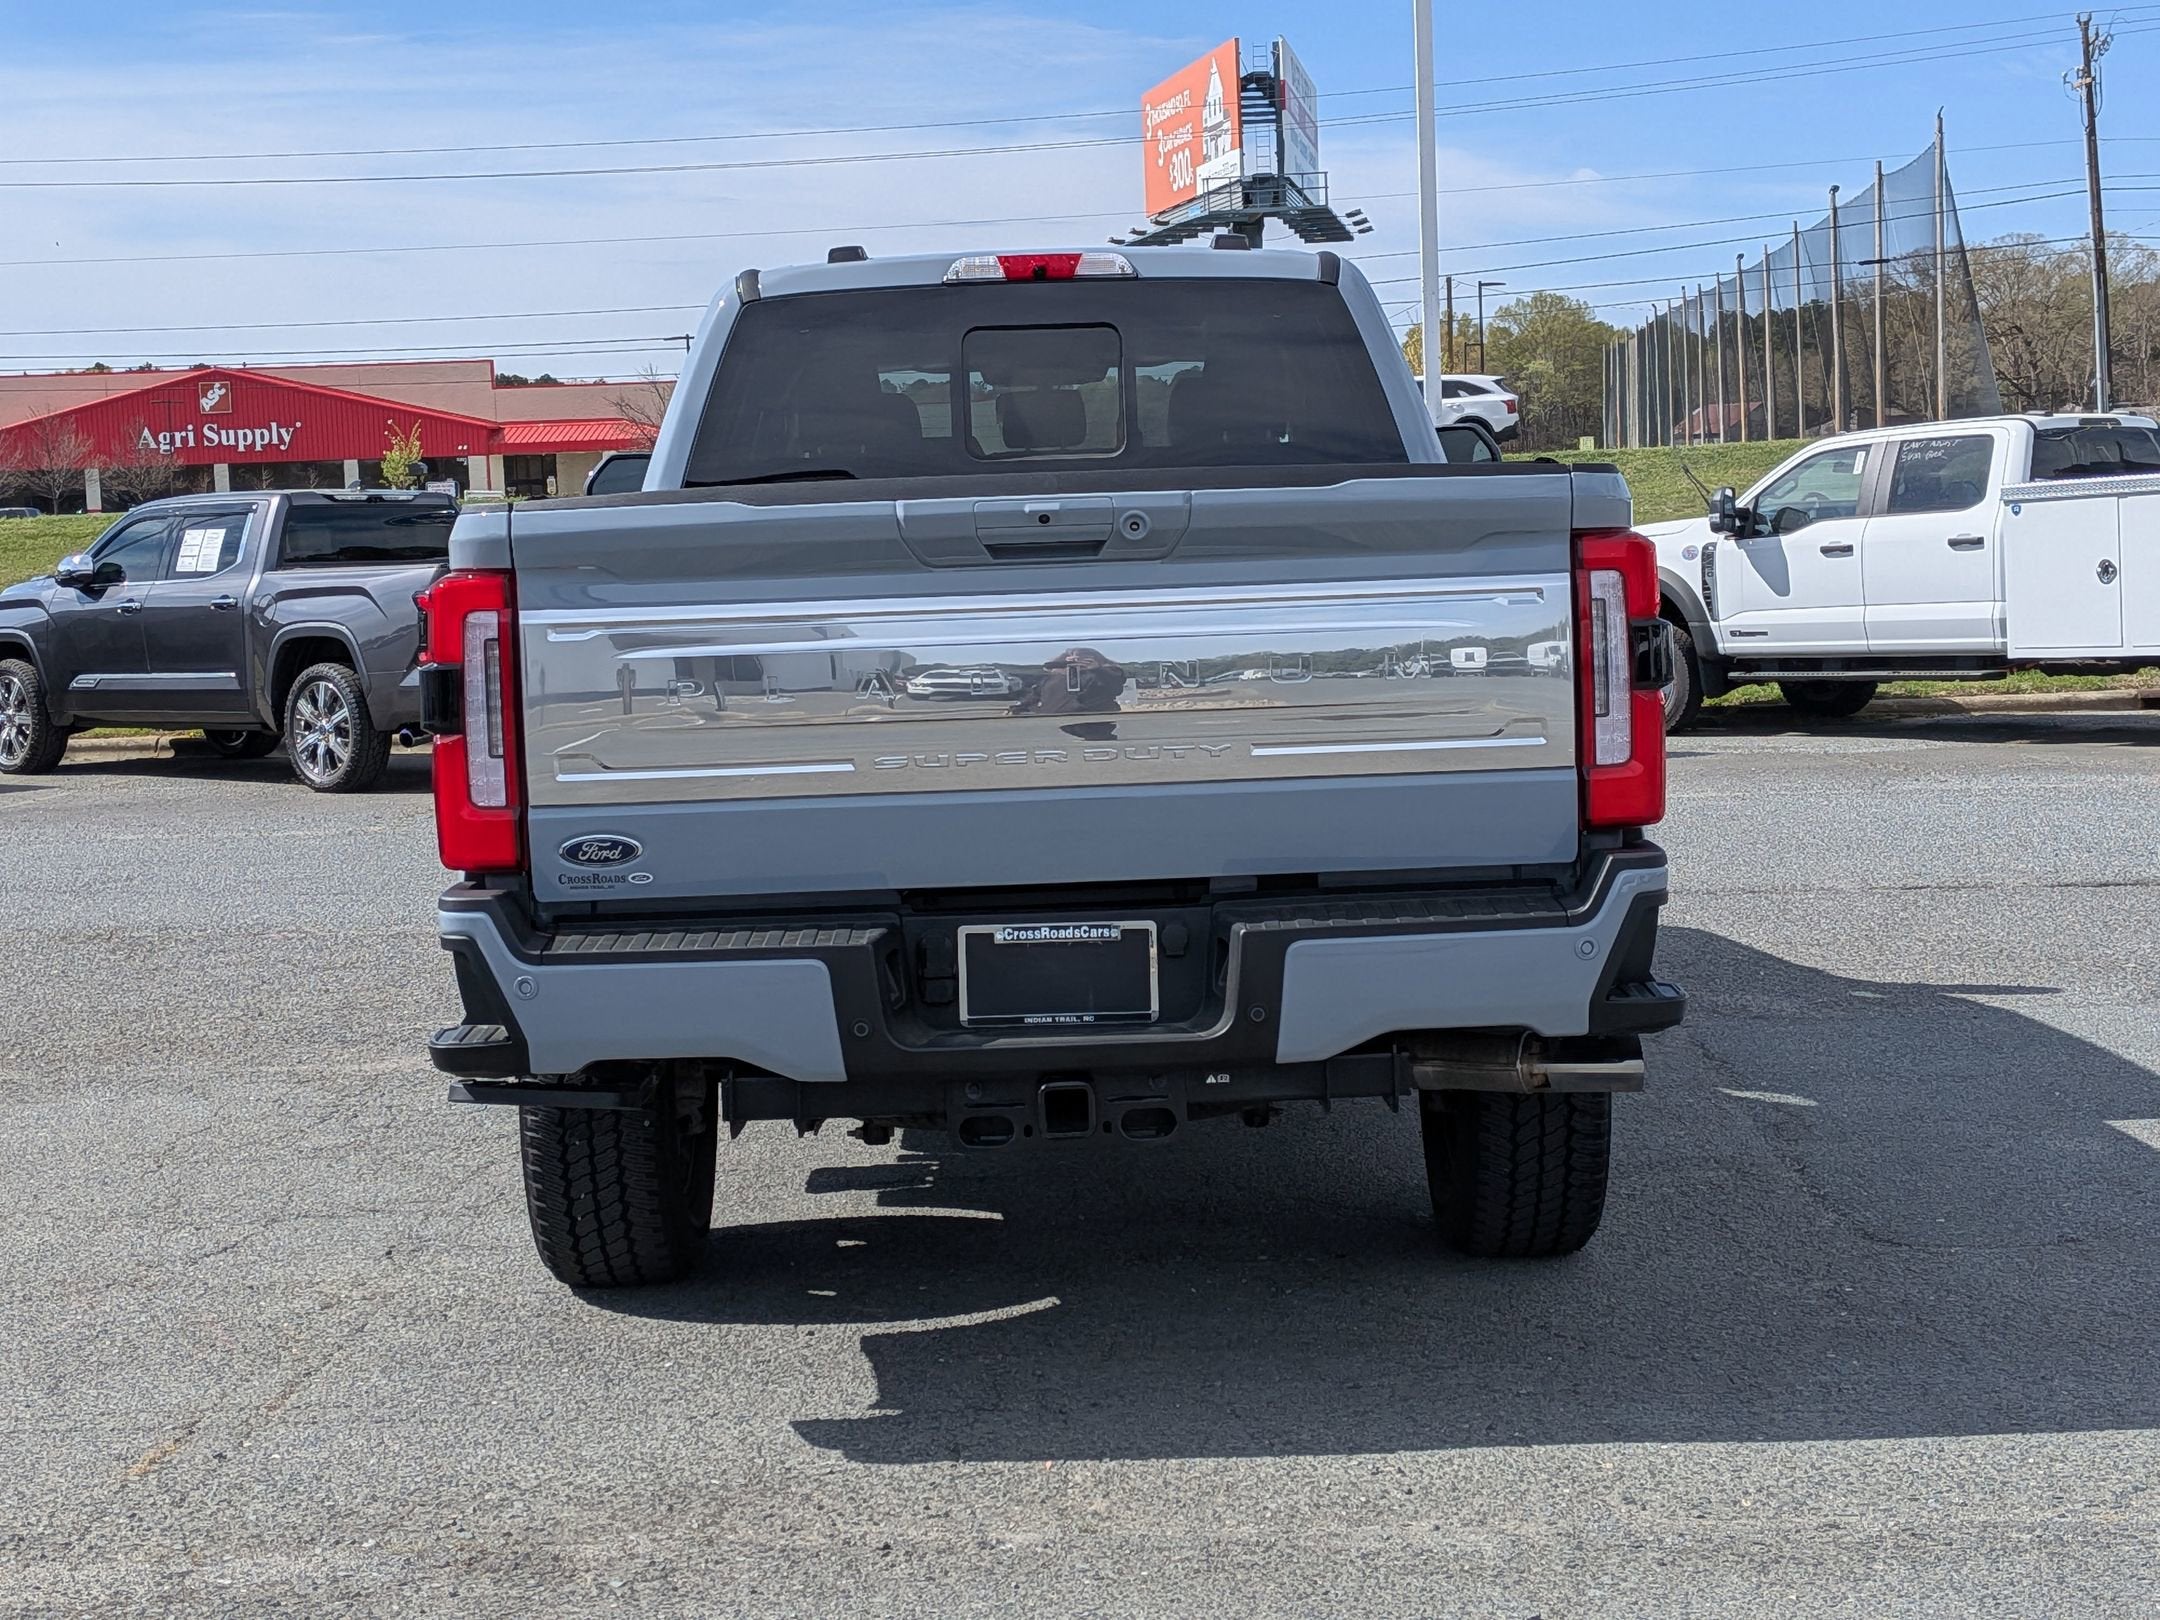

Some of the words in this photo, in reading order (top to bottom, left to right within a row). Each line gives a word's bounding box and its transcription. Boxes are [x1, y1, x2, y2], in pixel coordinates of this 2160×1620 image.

[200, 382, 226, 411] ASC
[138, 424, 196, 454] Agri
[874, 750, 1068, 770] SUPER
[1083, 743, 1232, 762] DUTY
[578, 841, 622, 861] Ford
